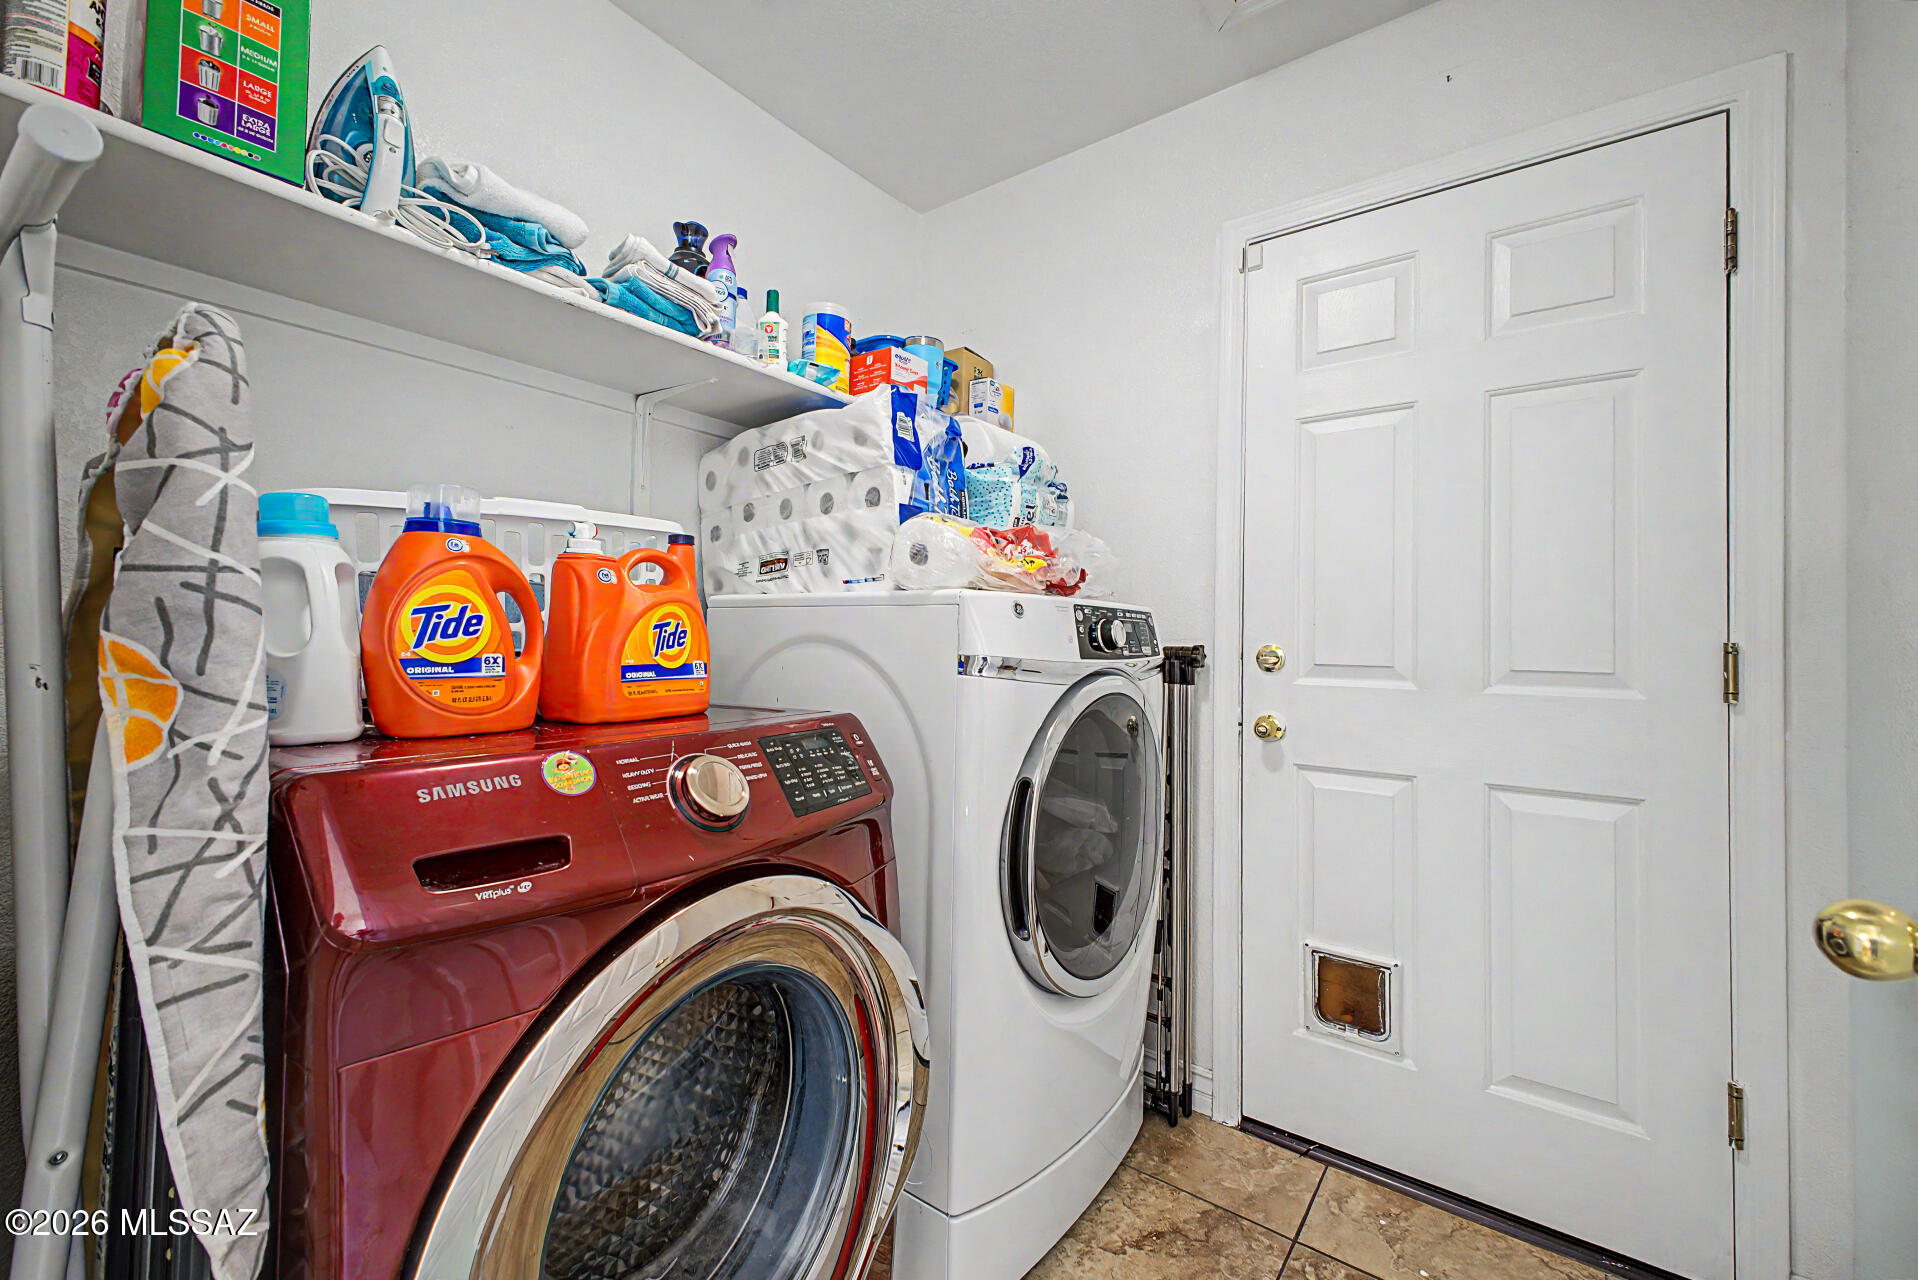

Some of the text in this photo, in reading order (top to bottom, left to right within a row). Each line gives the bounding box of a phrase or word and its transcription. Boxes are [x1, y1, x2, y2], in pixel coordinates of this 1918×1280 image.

[246, 14, 275, 33] SMALL
[241, 46, 277, 67] MEDIUM
[243, 80, 272, 98] LARGE
[410, 603, 485, 651] Tide
[652, 620, 688, 659] Tide
[406, 666, 455, 675] ORIGINAL
[484, 656, 501, 665] 6X
[416, 774, 522, 804] SAMSUNG
